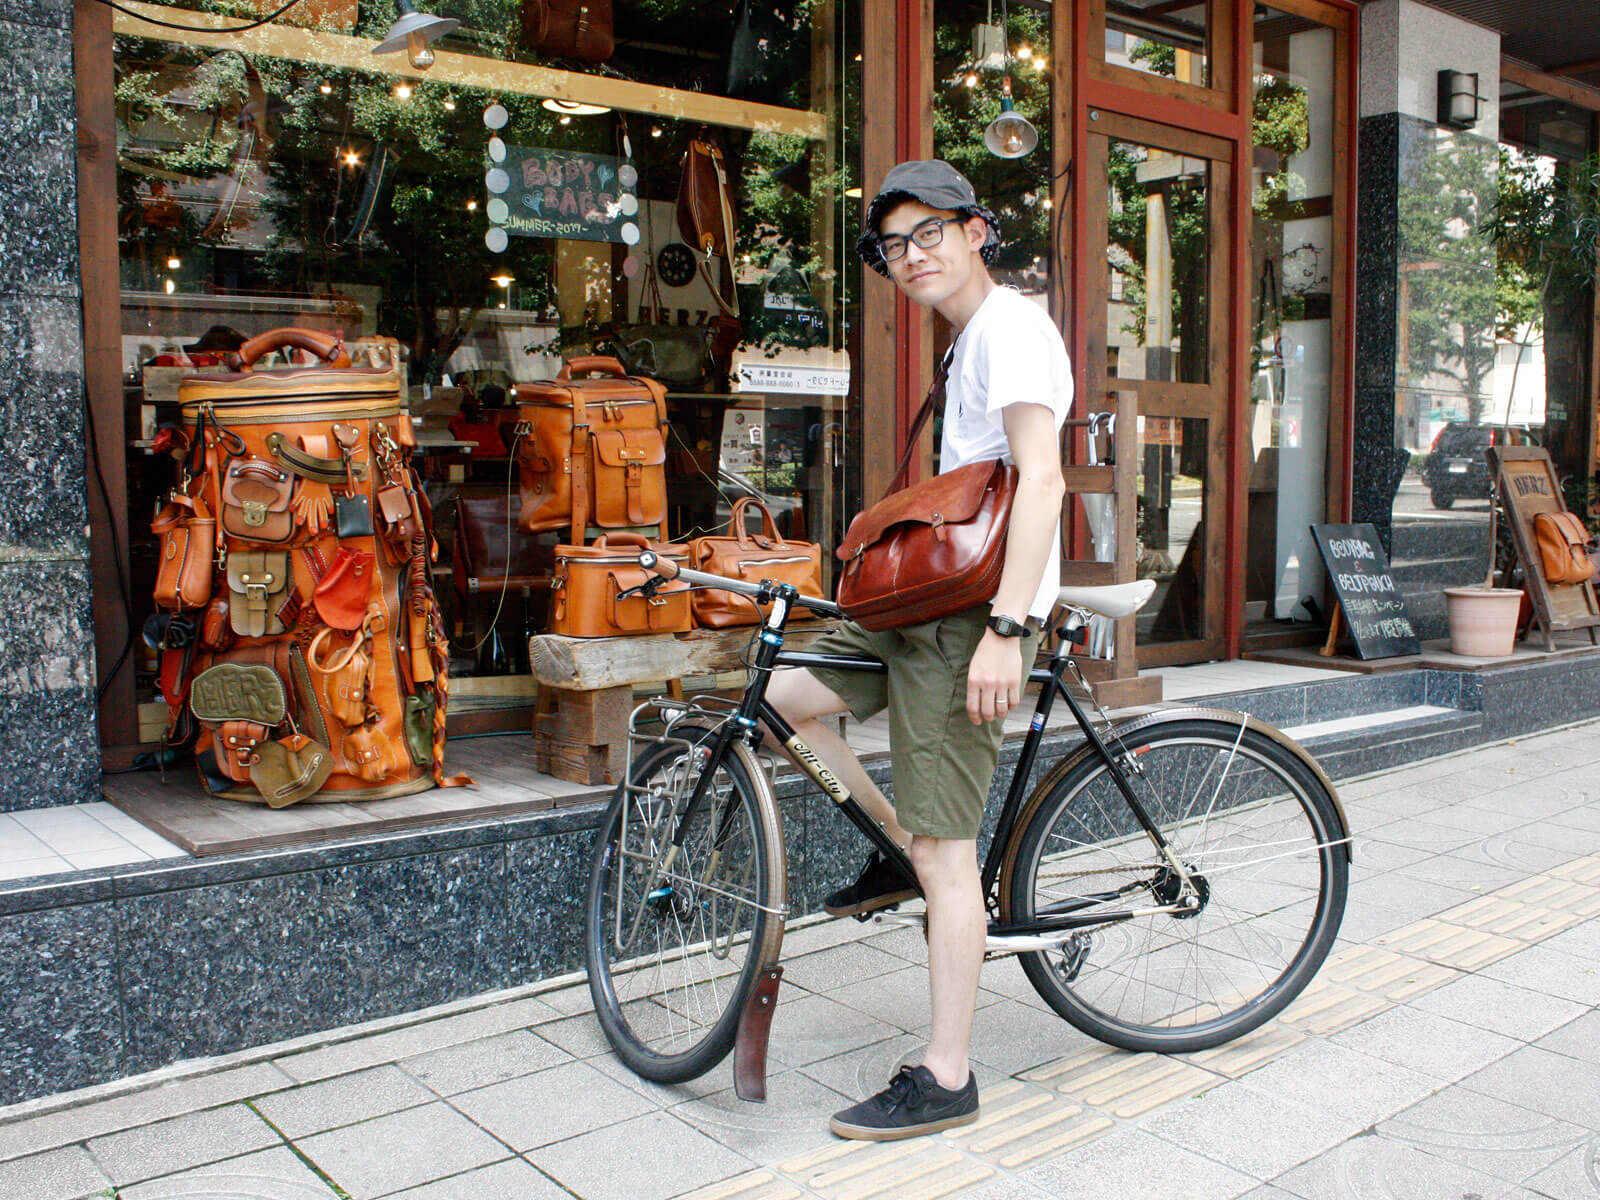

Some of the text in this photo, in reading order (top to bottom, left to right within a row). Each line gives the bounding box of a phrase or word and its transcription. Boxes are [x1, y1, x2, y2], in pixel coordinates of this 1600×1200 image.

[522, 158, 595, 188] BODY
[1513, 475, 1549, 496] HERZ
[1329, 538, 1376, 560] BODYBAG
[1338, 574, 1395, 593] BELTPOUCH
